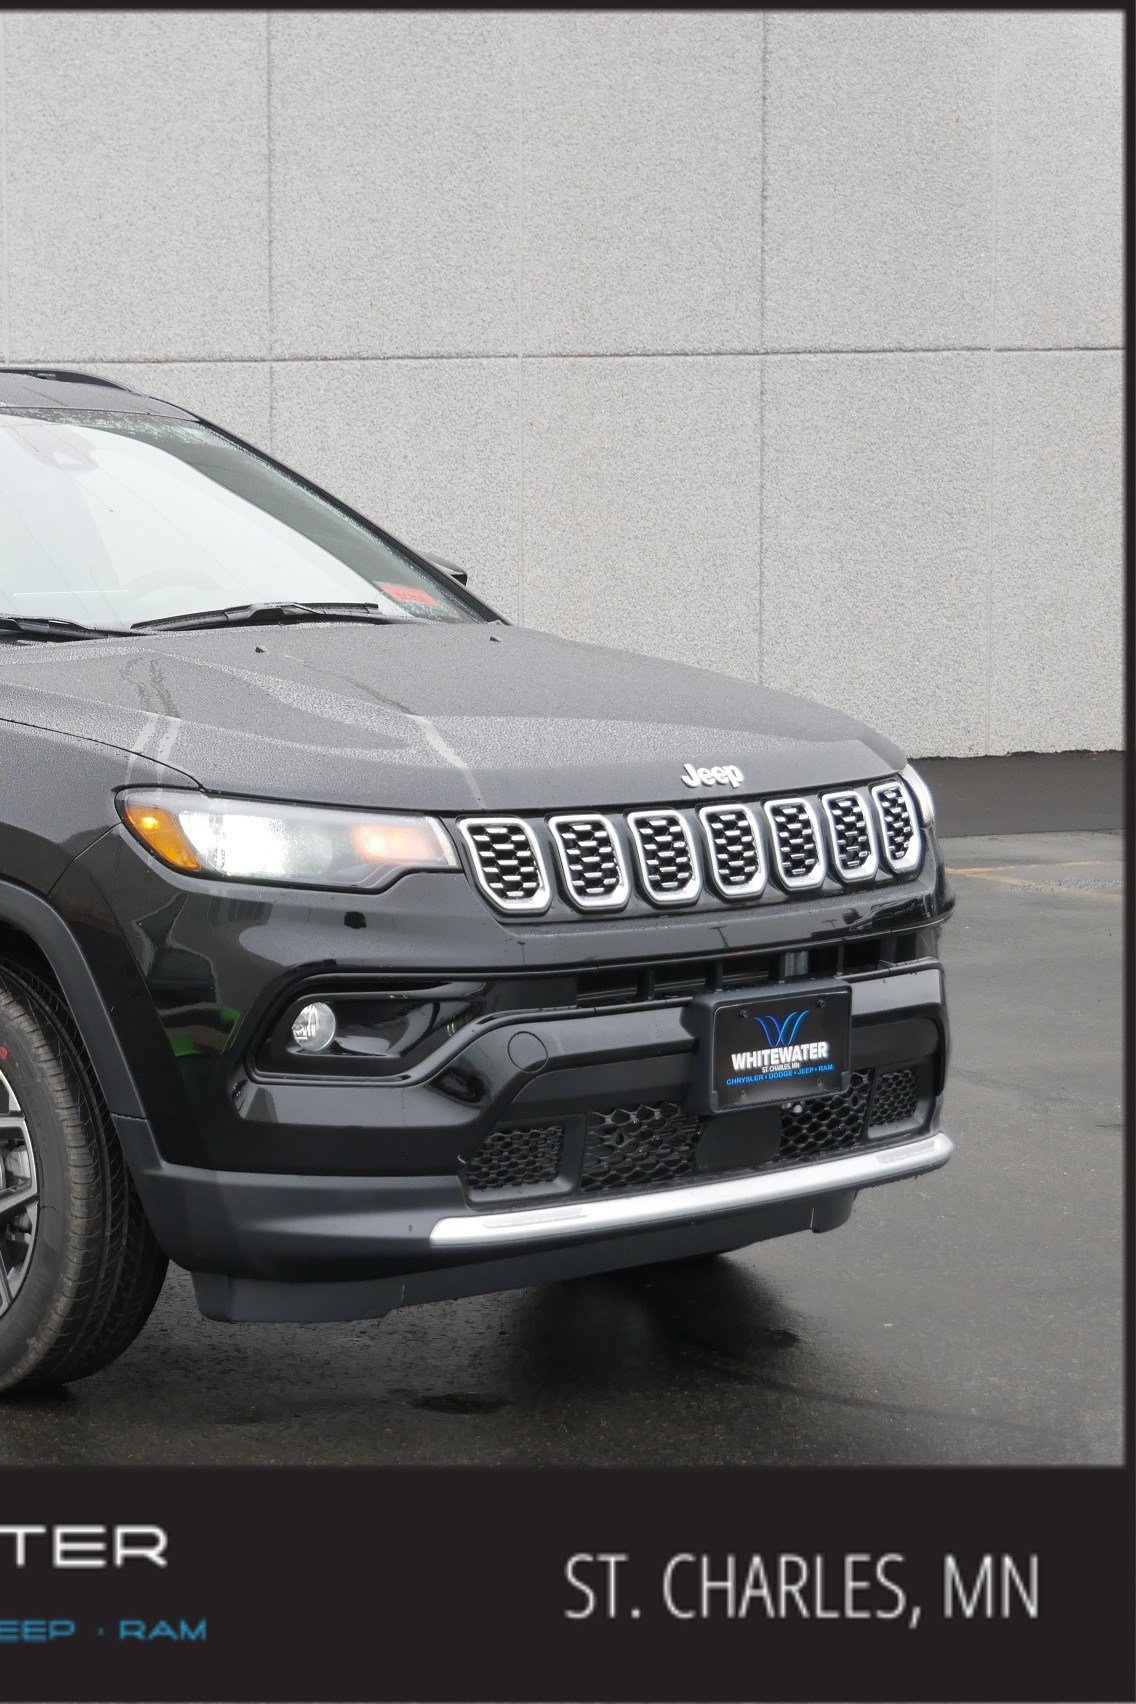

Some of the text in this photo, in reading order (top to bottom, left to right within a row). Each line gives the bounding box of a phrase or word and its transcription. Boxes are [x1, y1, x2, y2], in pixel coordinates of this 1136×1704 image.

[681, 763, 744, 789] Jeep
[731, 1041, 830, 1071] WHITEWATER
[726, 1063, 835, 1086] CHRYSLER DODGE JEEP RAM
